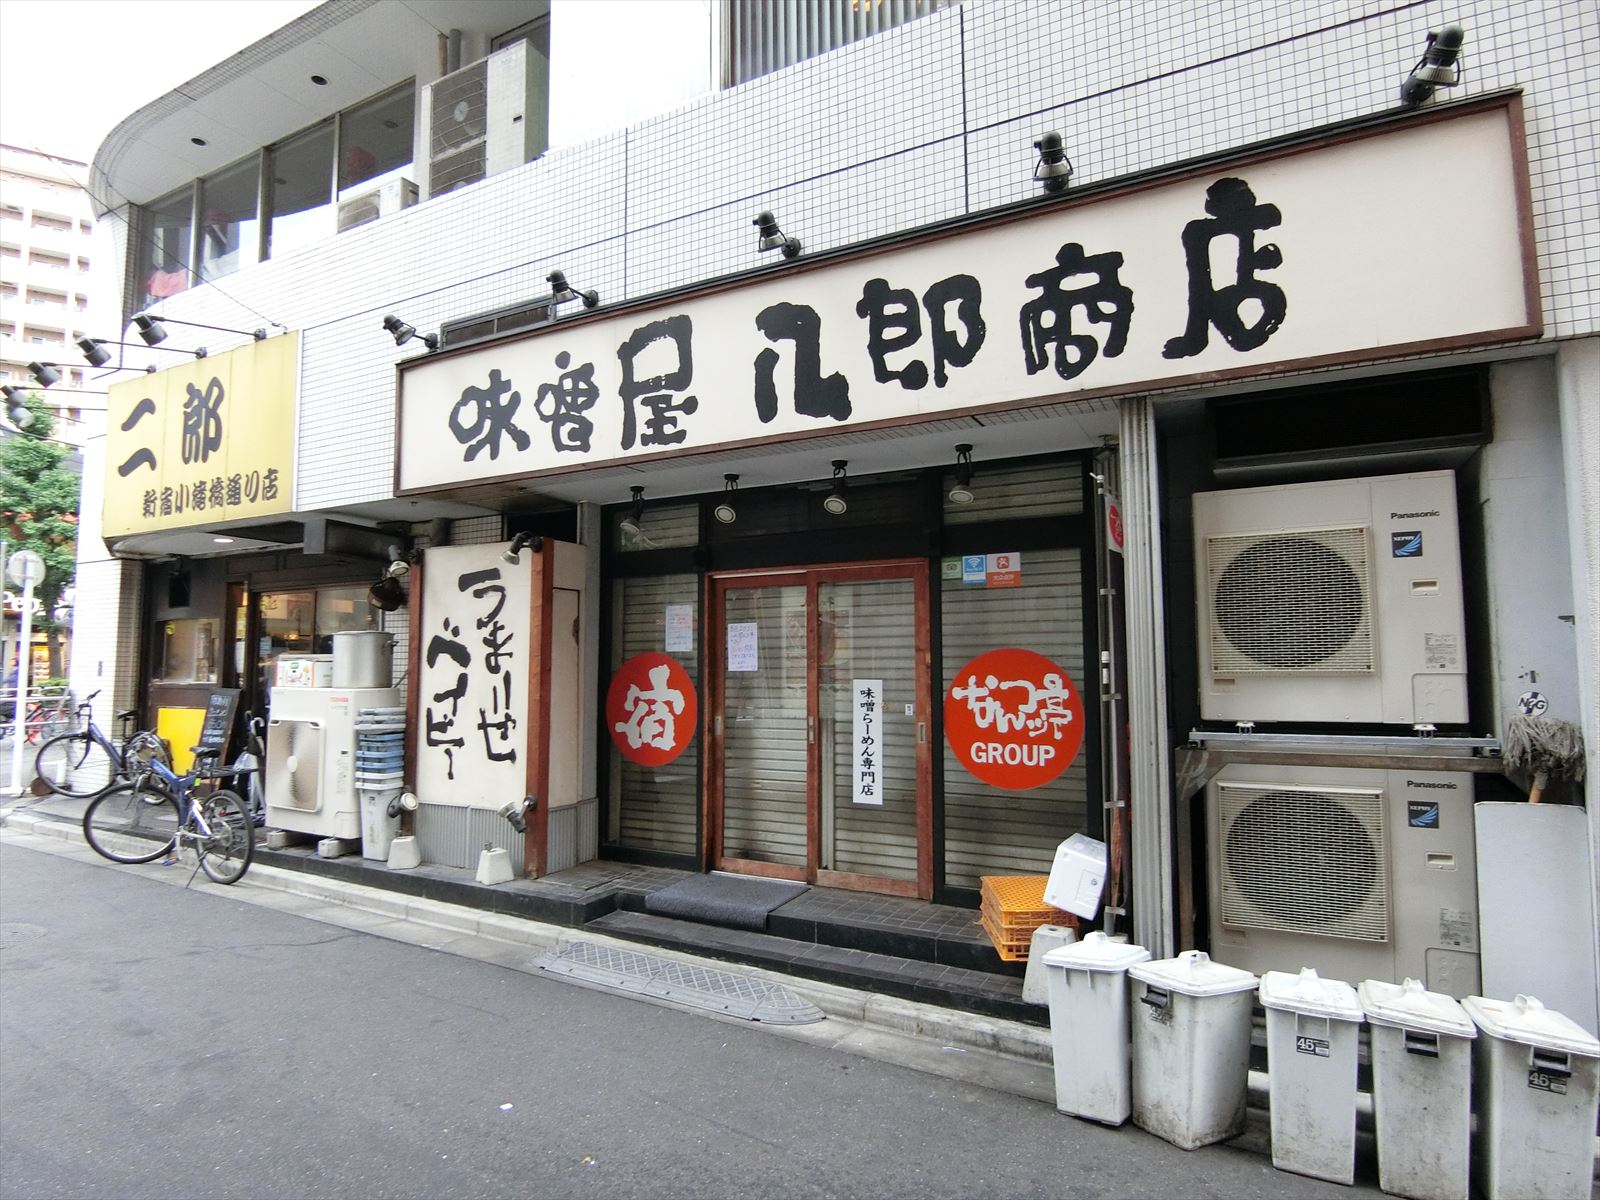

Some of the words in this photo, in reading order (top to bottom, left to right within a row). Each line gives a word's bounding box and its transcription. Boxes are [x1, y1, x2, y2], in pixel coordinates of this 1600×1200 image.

[449, 314, 696, 462] 味噌屋
[118, 377, 224, 477] 二郎
[1390, 509, 1440, 519] Panasonic
[615, 664, 686, 751] 宿
[859, 686, 876, 797] 味噌らーめん専門店
[970, 741, 1056, 767] GROUP
[1407, 780, 1457, 789] Panasonic
[1297, 1038, 1315, 1050] 45
[1529, 1072, 1550, 1087] 45
